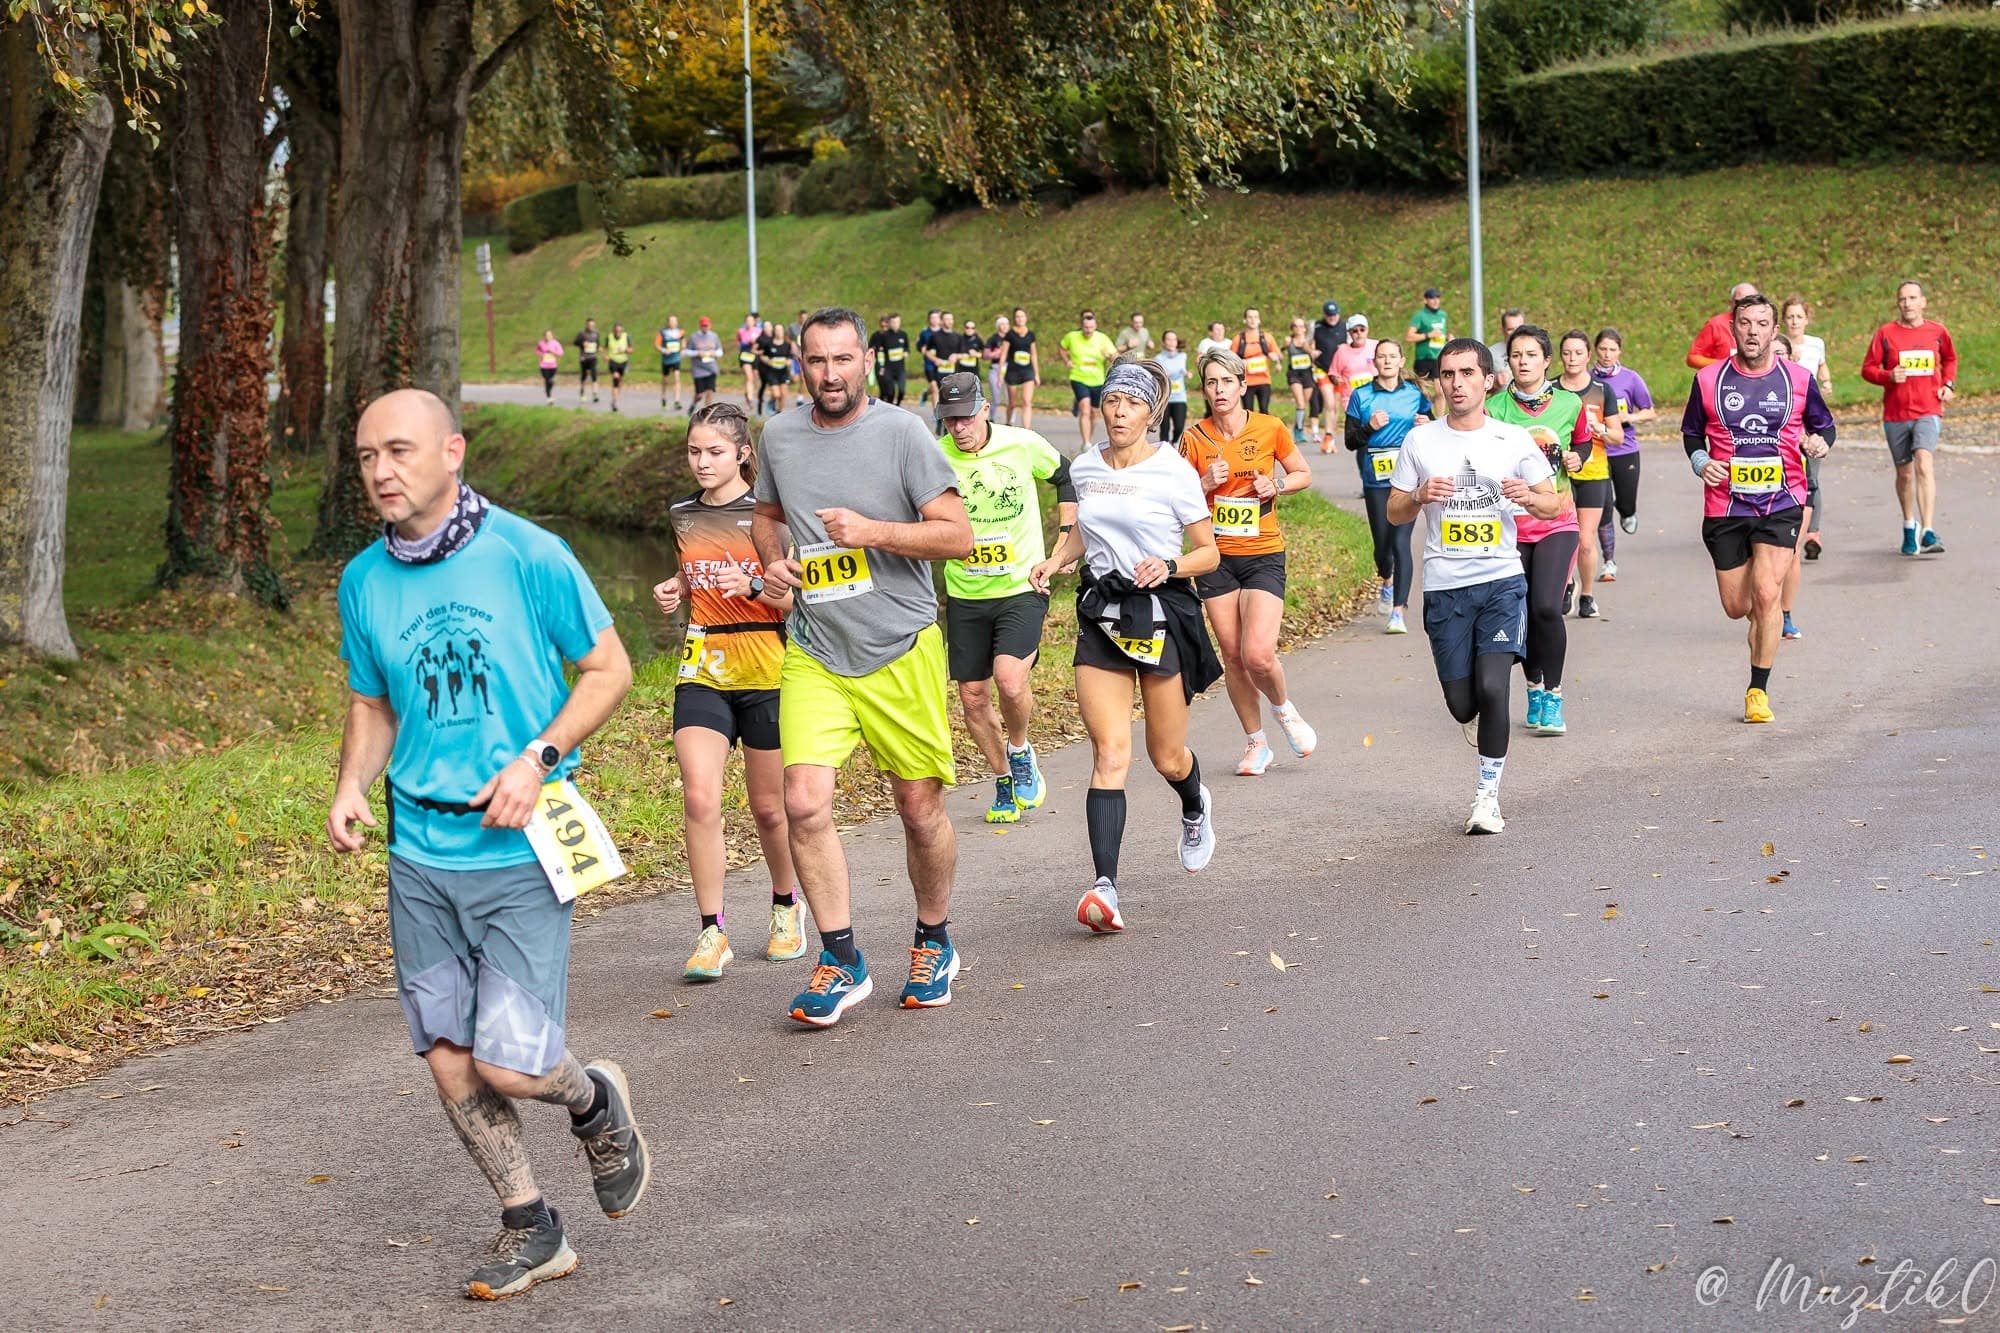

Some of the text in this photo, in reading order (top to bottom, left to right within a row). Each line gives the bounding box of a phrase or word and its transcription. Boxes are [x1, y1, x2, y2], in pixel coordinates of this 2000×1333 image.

[1732, 436, 1781, 446] Groupama
[1377, 459, 1393, 472] 51
[1737, 467, 1775, 483] 502
[1448, 498, 1459, 510] KM
[1460, 495, 1495, 511] PANTHEON
[1216, 507, 1253, 525] 692
[1449, 523, 1494, 543] 583
[695, 557, 760, 575] FOUÉE
[806, 555, 858, 585] 619
[399, 614, 425, 642] Trail
[426, 605, 447, 620] des
[450, 601, 495, 623] Forges
[545, 797, 600, 877] 494
